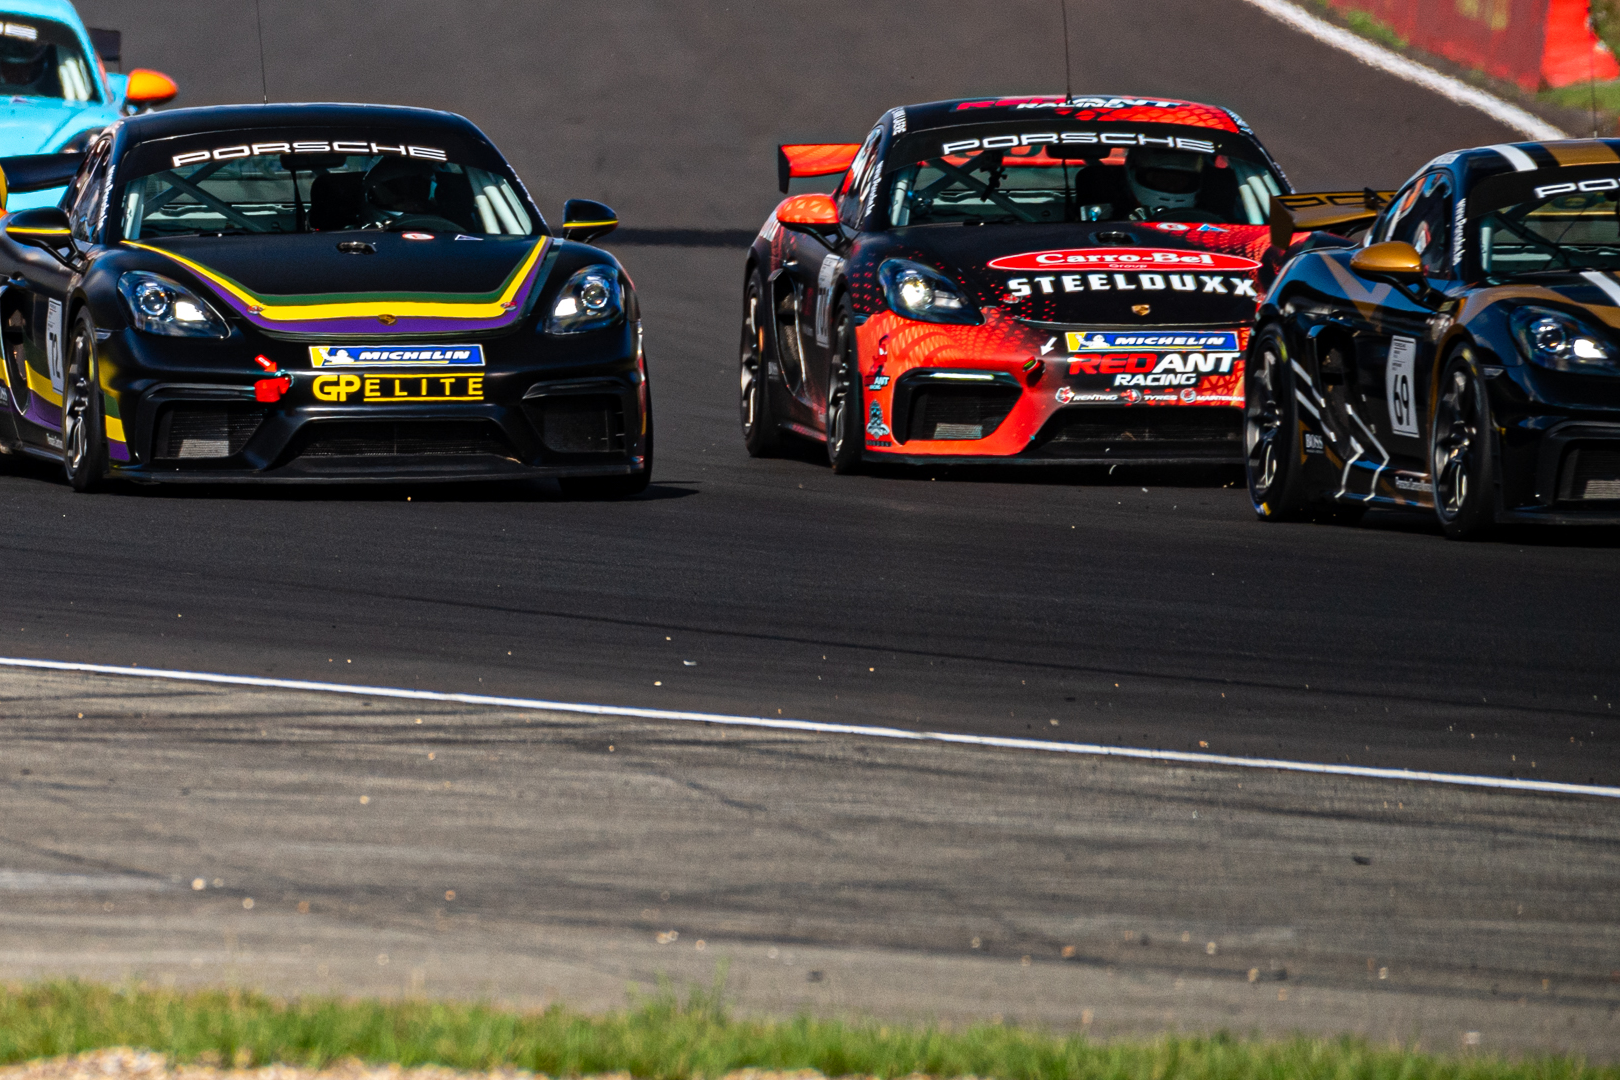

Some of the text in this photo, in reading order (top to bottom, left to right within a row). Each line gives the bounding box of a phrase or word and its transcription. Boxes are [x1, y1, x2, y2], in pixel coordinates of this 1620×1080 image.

[943, 132, 1216, 155] PORSCHE
[171, 141, 448, 168] PORSCHE
[1534, 178, 1620, 199] PO
[1035, 252, 1214, 265] Carro-Bel
[1006, 273, 1258, 297] STEELDUXX
[1114, 336, 1226, 345] MICHELIN
[358, 350, 471, 360] MICHELIN
[1113, 373, 1197, 386] RACING
[1393, 374, 1410, 426] 69
